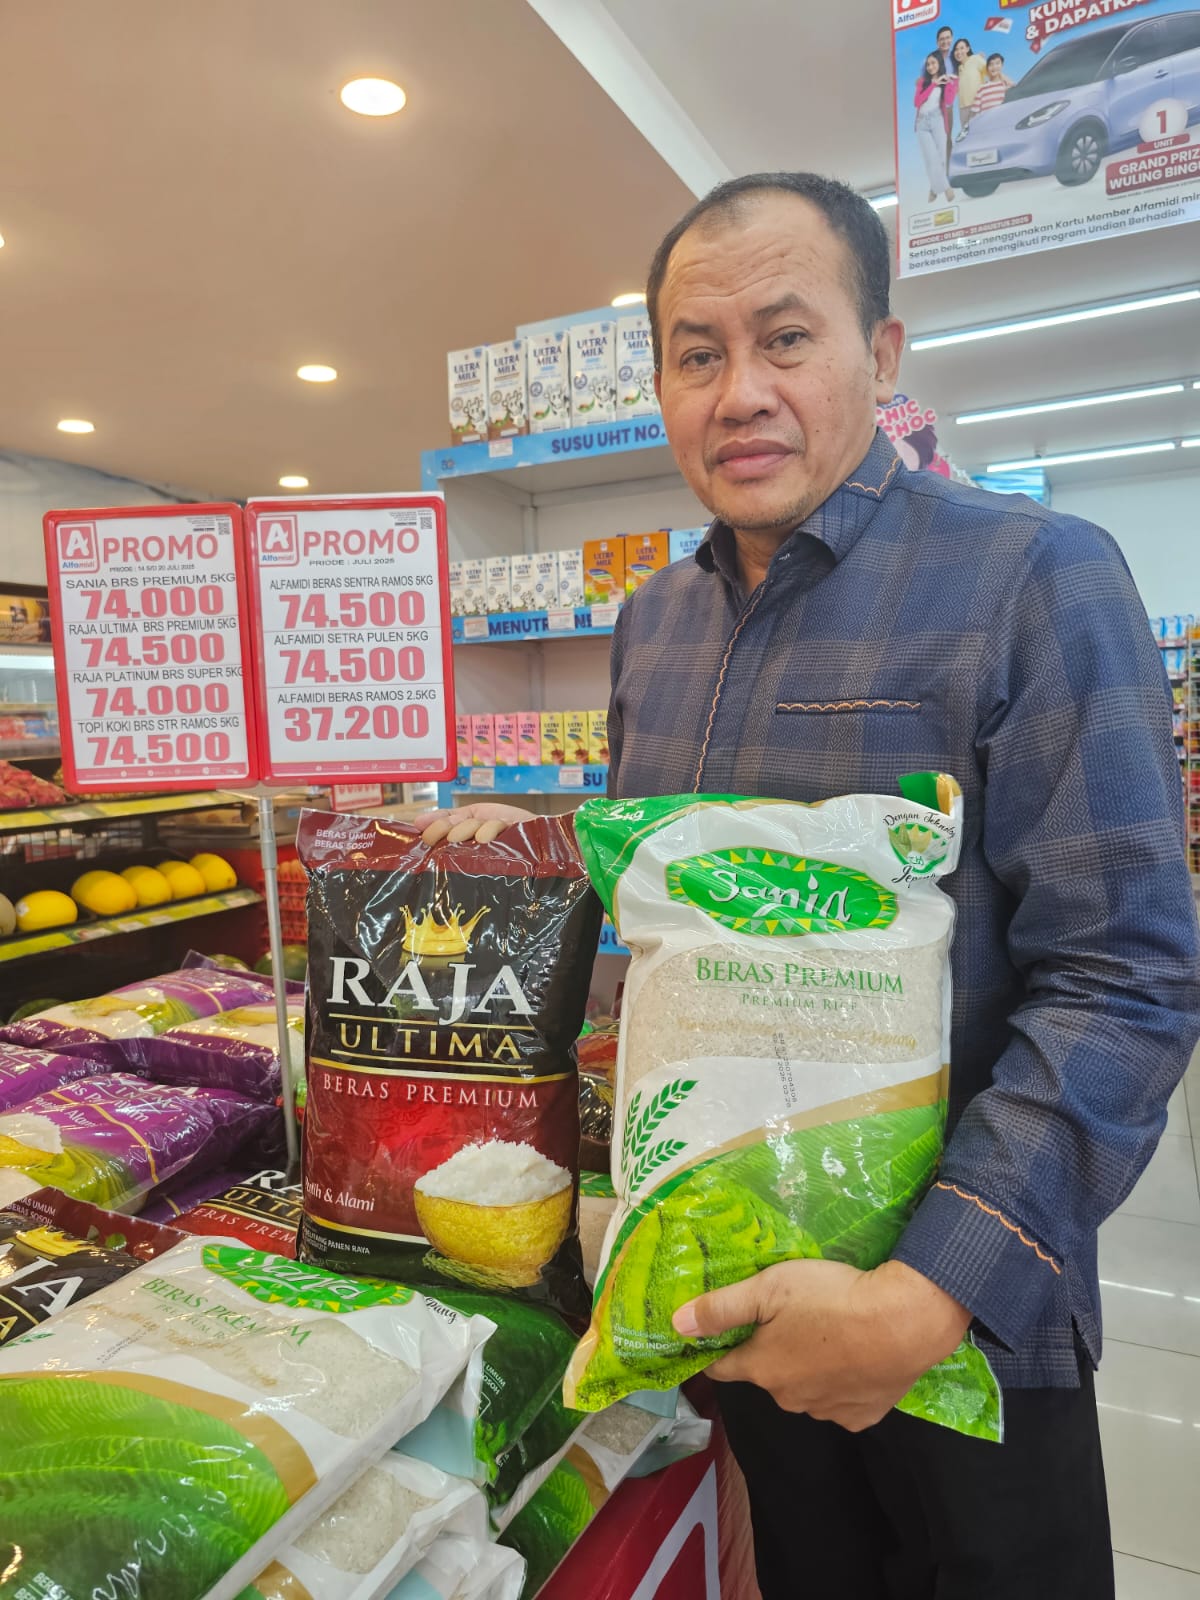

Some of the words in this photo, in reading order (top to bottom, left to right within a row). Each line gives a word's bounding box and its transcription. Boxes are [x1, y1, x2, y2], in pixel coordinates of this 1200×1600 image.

[897, 6, 934, 24] Alfamidi
[1026, 26, 1039, 40] &
[1156, 110, 1167, 134] 1
[1153, 138, 1175, 149] UNIT
[1118, 155, 1168, 175] GRAND
[1109, 170, 1162, 190] WULING
[909, 246, 939, 259] Setiap
[980, 222, 1054, 246] menggunakan
[1055, 216, 1084, 229] Kartu
[1086, 208, 1131, 223] Member
[1133, 194, 1179, 213] Alfamidi
[909, 247, 986, 270] berkesempatan
[987, 236, 1040, 254] mengikuti
[1041, 228, 1087, 243] Program
[1088, 220, 1127, 234] Undian
[1128, 208, 1186, 226] Berhadiah
[577, 337, 608, 349] ULTRA
[624, 330, 649, 340] ULTR
[494, 354, 520, 367] ULTRA
[533, 345, 562, 357] ULTRA
[454, 362, 480, 374] ULTRA
[551, 437, 593, 454] SUSU
[598, 428, 632, 447] UHT
[103, 533, 219, 564] PROMO
[303, 528, 420, 557] PROMO
[62, 560, 95, 569] Alfamidi
[261, 554, 294, 562] Alfamidi
[66, 579, 107, 589] SANIA
[111, 576, 139, 587] BRS
[142, 574, 207, 586] PREMIUM
[210, 573, 236, 583] 5KG
[270, 578, 311, 590] ALFAMIDI
[312, 577, 342, 589] BERAS
[344, 576, 381, 588] SENTRA
[382, 575, 413, 587] RAMOS
[415, 575, 434, 586] 5KG
[80, 584, 225, 620] 74.000
[279, 591, 426, 629] 74.500
[69, 623, 97, 635] RAJA
[100, 622, 138, 634] ULTIMA
[143, 621, 164, 632] BRS
[167, 618, 216, 631] PREMIUM
[217, 617, 237, 629] 5KG
[274, 633, 324, 645] ALFAMIDI
[328, 632, 364, 644] SETRA
[367, 631, 404, 643] PULEN
[406, 630, 429, 641] 5KG
[81, 632, 225, 668] 74.500
[279, 646, 426, 684] 74.500
[73, 672, 102, 684] RAJA
[106, 670, 160, 682] PLATINUM
[162, 668, 185, 680] BRS
[187, 667, 222, 679] SUPER
[85, 683, 230, 718] 74.000
[278, 692, 326, 704] ALFAMIDI
[328, 691, 364, 703] BERAS
[366, 690, 404, 701] RAMOS
[406, 689, 436, 700] 2.5KG
[78, 721, 104, 733] TOPI
[106, 720, 131, 732] KOKI
[134, 719, 155, 731] BRS
[157, 718, 178, 730] STR
[181, 717, 217, 729] RAMOS
[220, 716, 240, 727] 5KG
[284, 704, 429, 742] 37.200
[87, 732, 231, 766] 74.500
[314, 839, 344, 849] BERAS
[316, 828, 347, 840] BERAS
[349, 830, 377, 841] UMUM
[708, 871, 853, 922] Sania
[696, 957, 774, 984] BERAS
[784, 962, 904, 995] PREMIUM
[326, 956, 539, 1026] RAJA
[742, 993, 815, 1010] PREMIUM
[340, 1023, 521, 1060] ULTIMA
[323, 1073, 390, 1099] BERAS
[407, 1083, 540, 1108] PREMIUM
[32, 1201, 56, 1217] UMUM
[323, 1188, 333, 1203] &
[335, 1191, 375, 1212] Alami
[328, 1240, 351, 1251] PANEN
[352, 1245, 370, 1255] RAYA
[142, 1278, 208, 1308] BERAS
[424, 1296, 457, 1325] epang
[613, 1335, 622, 1345] PT
[624, 1338, 644, 1349] PADI
[480, 1374, 500, 1395] OSOH
[485, 1364, 506, 1388] UMUM
